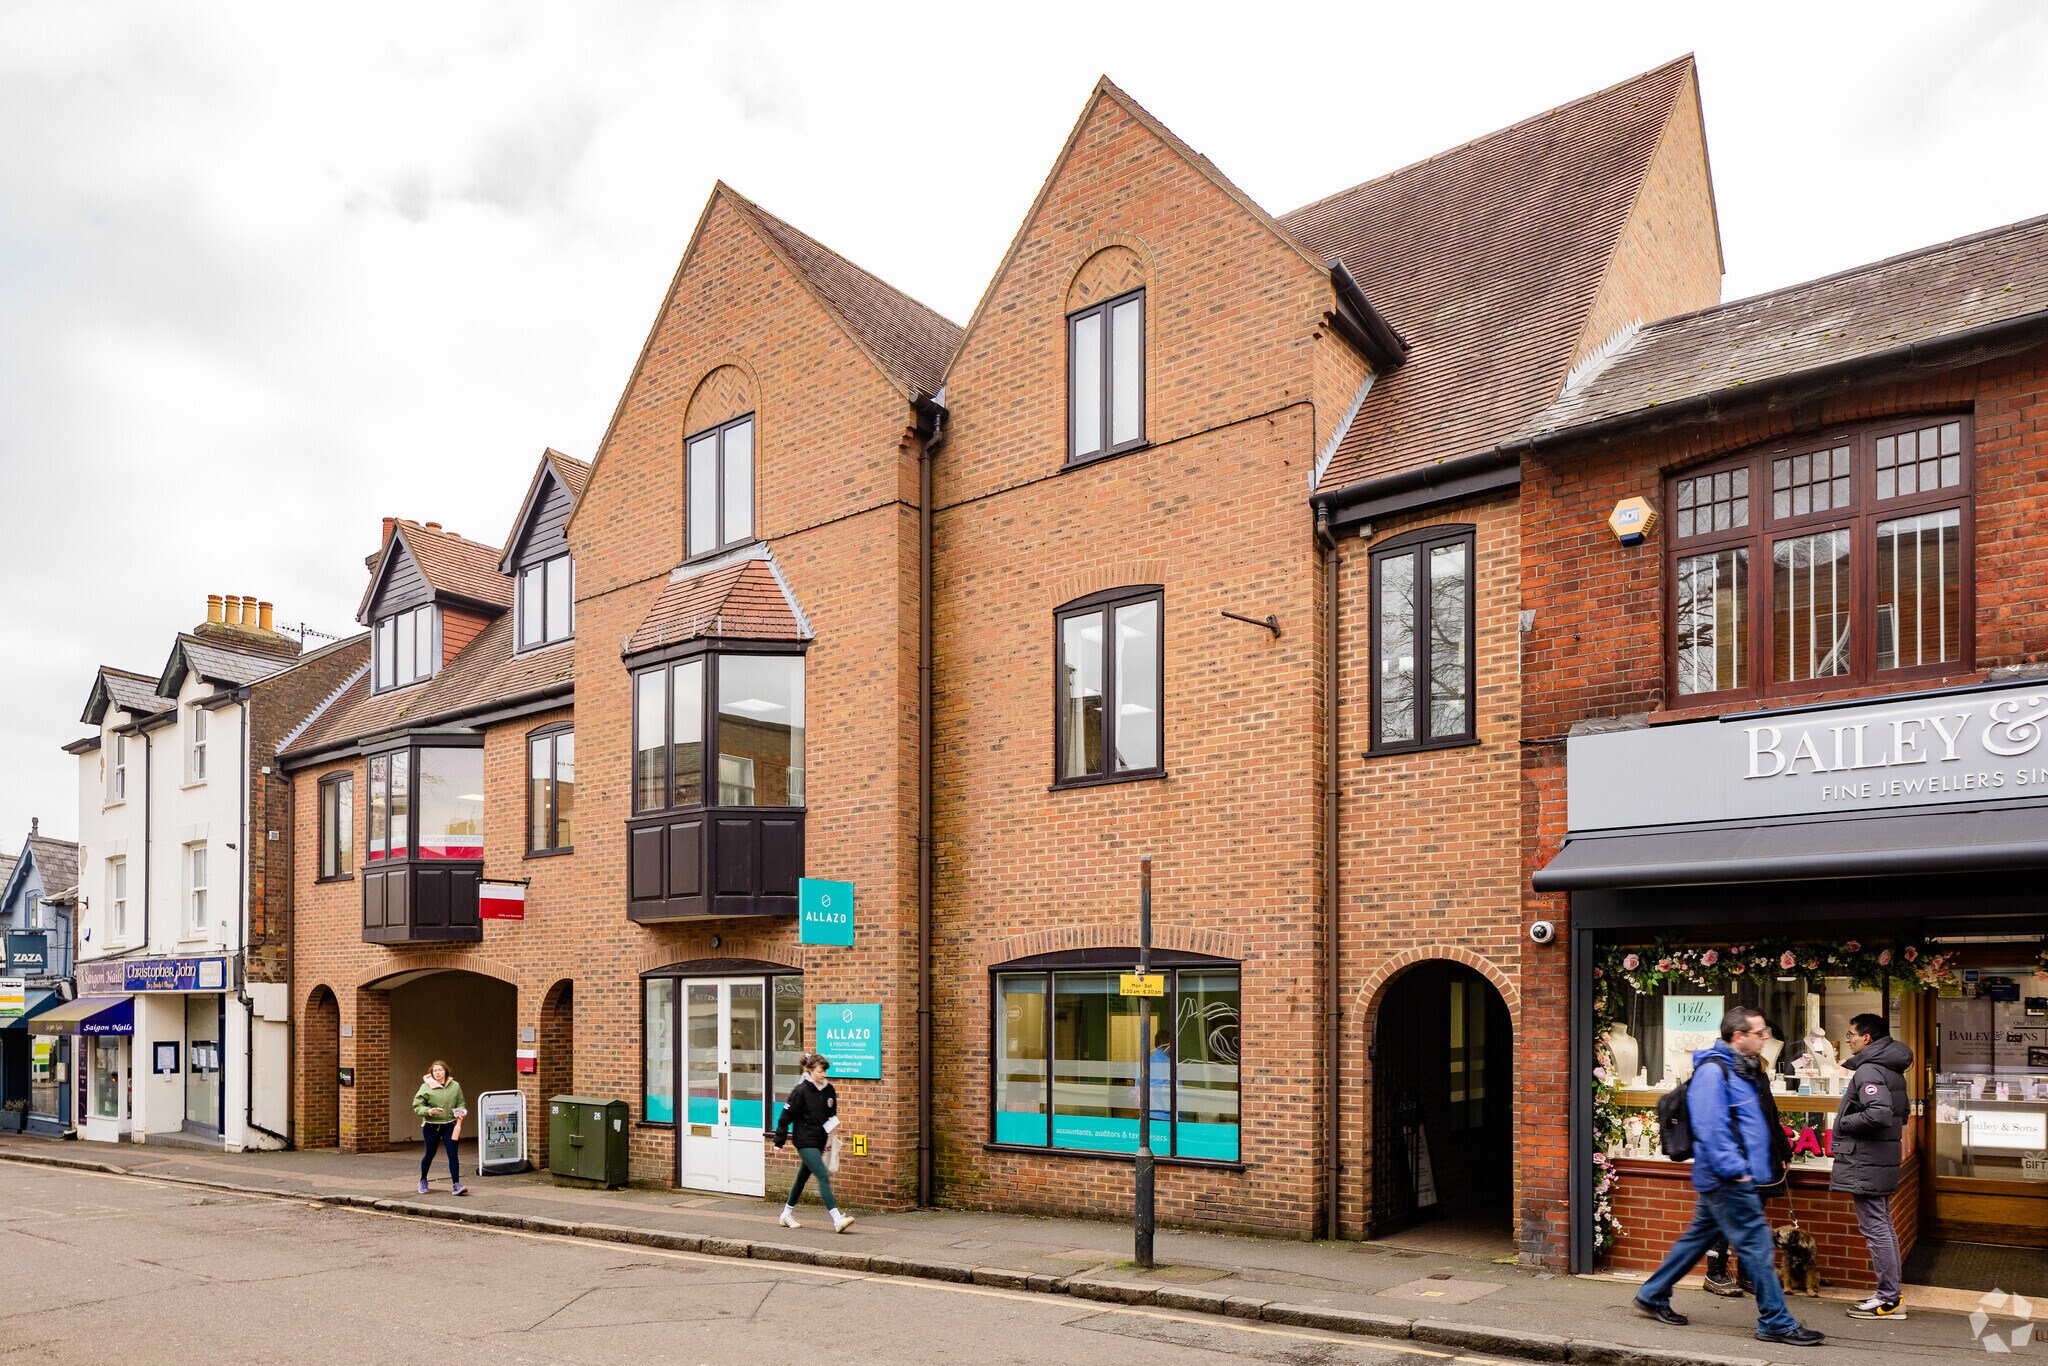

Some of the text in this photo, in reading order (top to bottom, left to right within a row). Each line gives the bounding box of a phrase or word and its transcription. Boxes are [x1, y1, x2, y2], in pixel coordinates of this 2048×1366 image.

[1620, 510, 1639, 522] ADT
[1744, 696, 2048, 780] BAILEY &
[1822, 783, 1872, 801] FINE
[1878, 772, 2004, 796] JEWELLERS
[806, 912, 846, 924] ALLAZO
[13, 953, 43, 962] ZAZA
[127, 961, 174, 980] Christopher
[175, 961, 196, 979] John
[84, 970, 122, 988] Saigon Nails
[1678, 1002, 1704, 1014] Will
[1680, 1012, 1711, 1025] you?
[84, 1024, 109, 1032] Saigon
[782, 1018, 796, 1046] 2
[826, 1028, 870, 1040] ALLAZO
[1949, 1030, 1992, 1040] BAILEY
[1994, 1031, 2004, 1041] &
[1056, 1127, 1093, 1136] accountants,
[1094, 1130, 1120, 1138] auditors
[2001, 1123, 2010, 1132] &
[2012, 1124, 2038, 1132] Sons
[855, 1138, 864, 1153] H
[2025, 1160, 2046, 1169] GIFT
